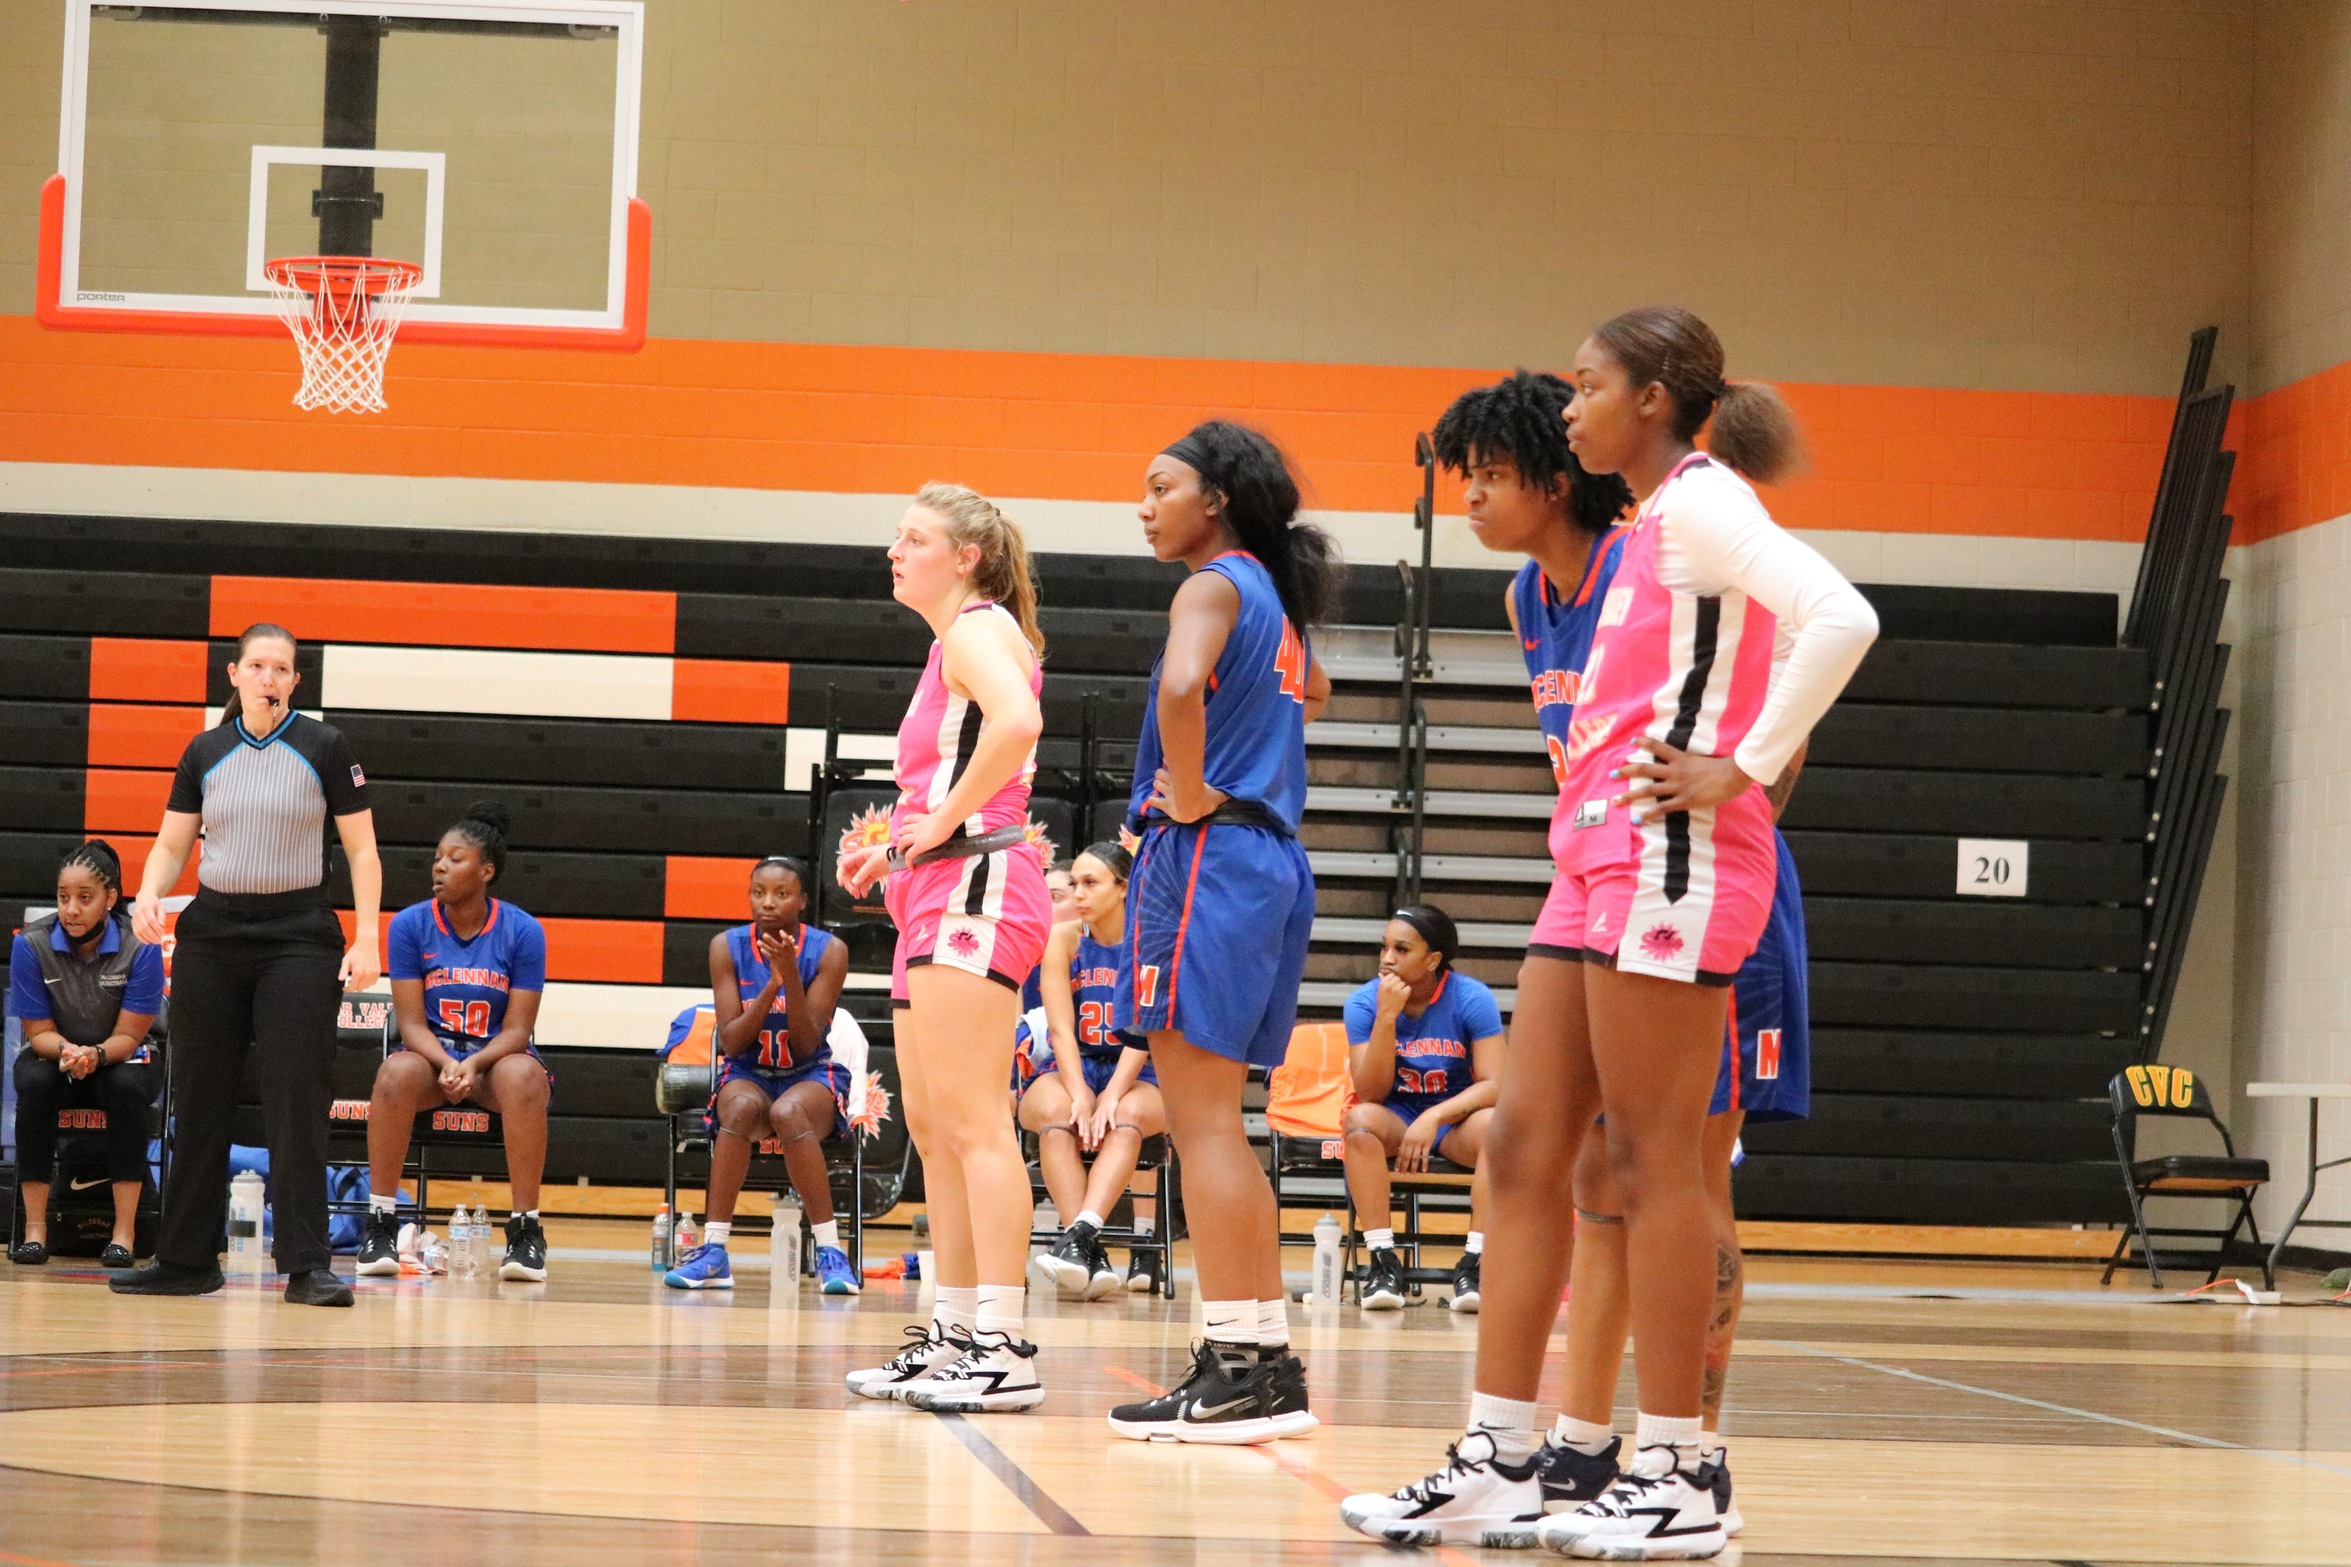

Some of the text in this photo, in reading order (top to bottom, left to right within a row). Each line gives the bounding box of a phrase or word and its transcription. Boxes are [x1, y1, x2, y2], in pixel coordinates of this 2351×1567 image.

[1974, 857, 2010, 885] 20
[439, 998, 491, 1037] 50
[758, 1030, 793, 1069] 11
[1398, 1067, 1448, 1094] 30
[2125, 1065, 2193, 1108] CVC
[432, 1111, 489, 1132] SUNS
